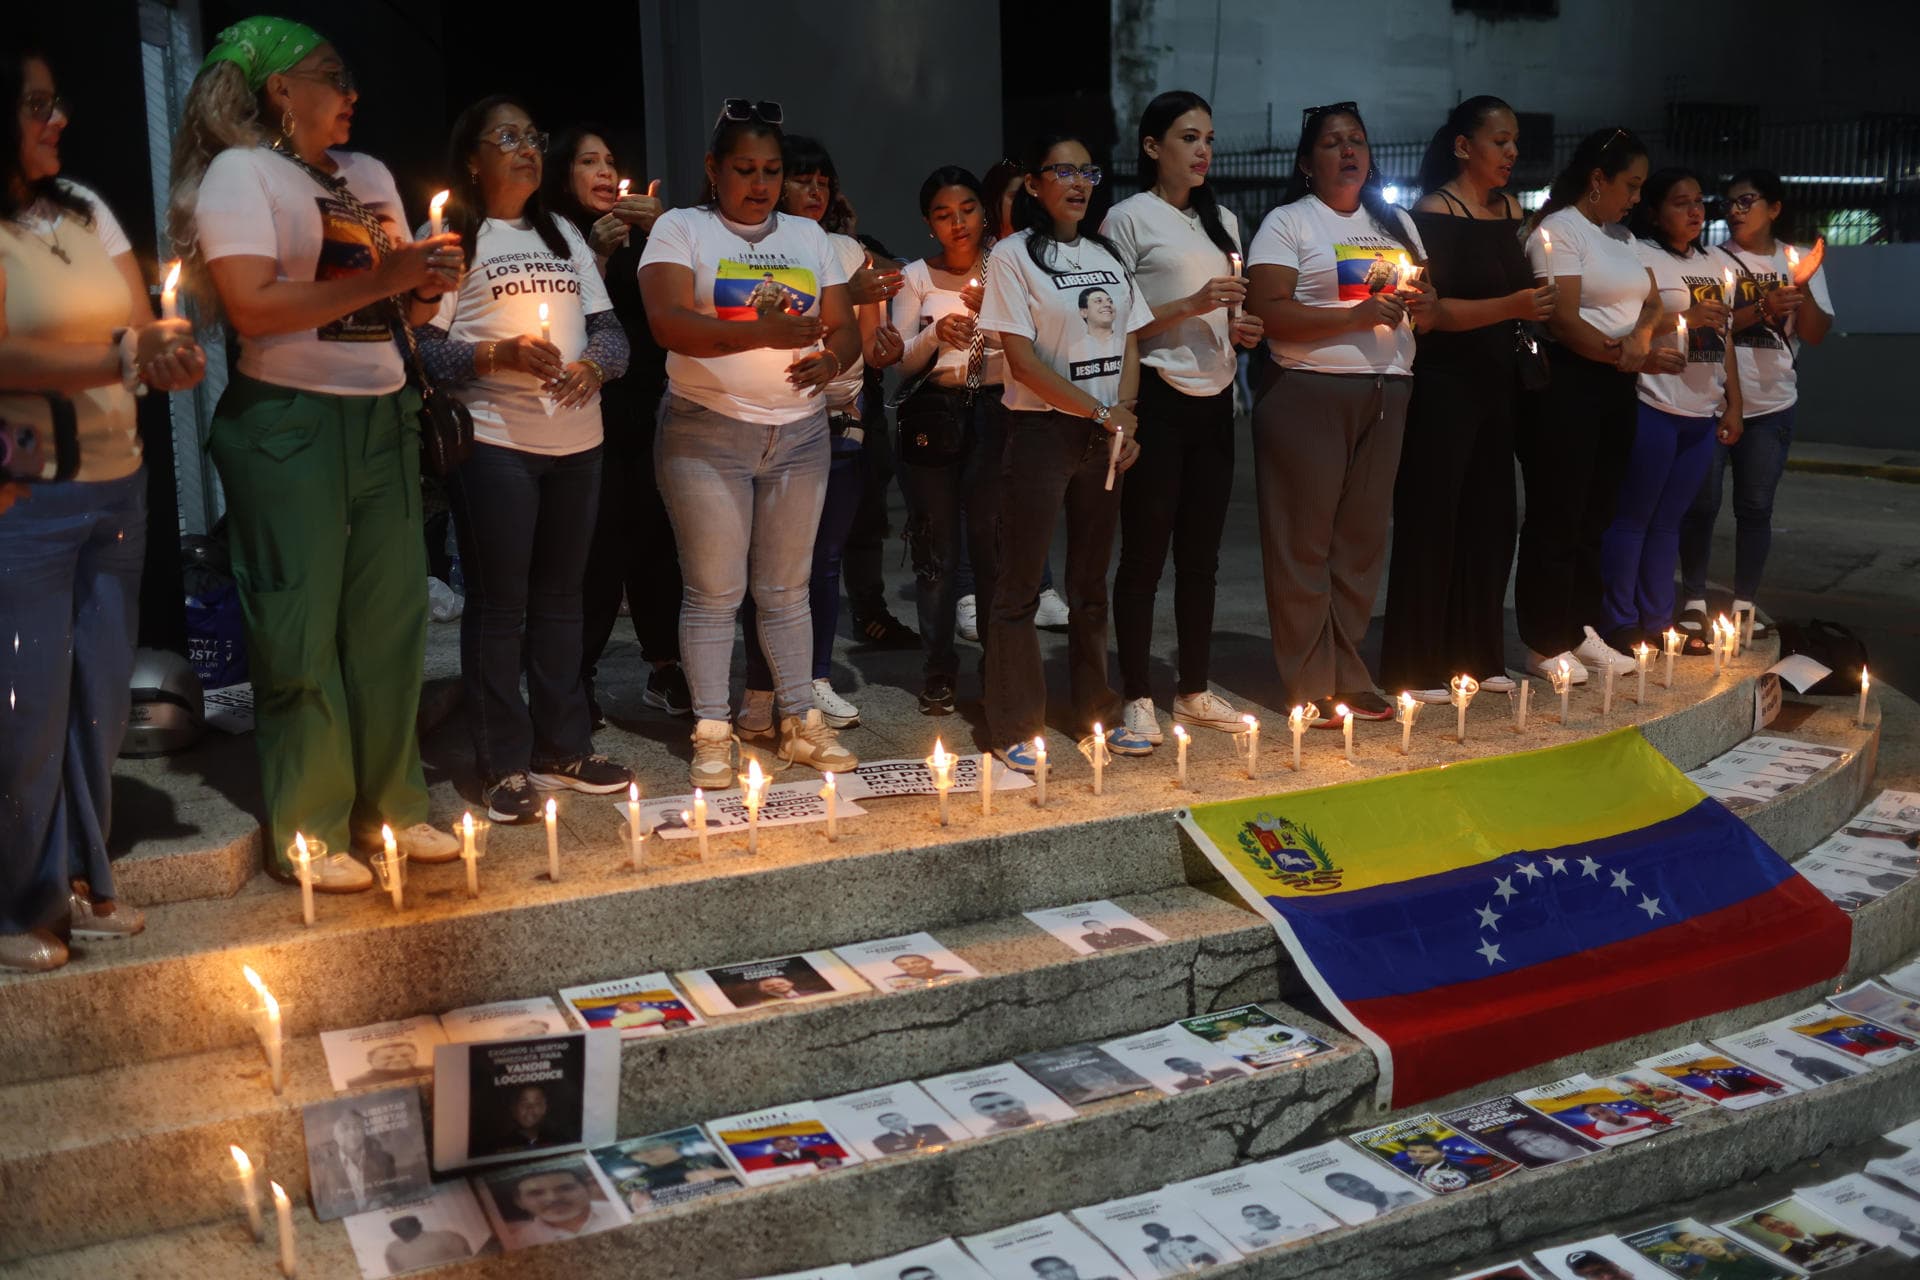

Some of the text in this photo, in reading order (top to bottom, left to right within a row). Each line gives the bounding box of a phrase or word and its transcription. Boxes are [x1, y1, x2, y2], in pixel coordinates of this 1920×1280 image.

[481, 252, 532, 267] LIBEREN
[486, 262, 578, 280] LOS PRESO
[492, 273, 581, 300] POLÍTICOS
[1055, 272, 1117, 287] LIBEREN A
[1681, 276, 1717, 285] LIBEREN
[855, 764, 919, 775] MENOS
[862, 773, 894, 781] DE
[732, 803, 819, 817] PESOS
[1468, 1113, 1529, 1131] GRATEROL
